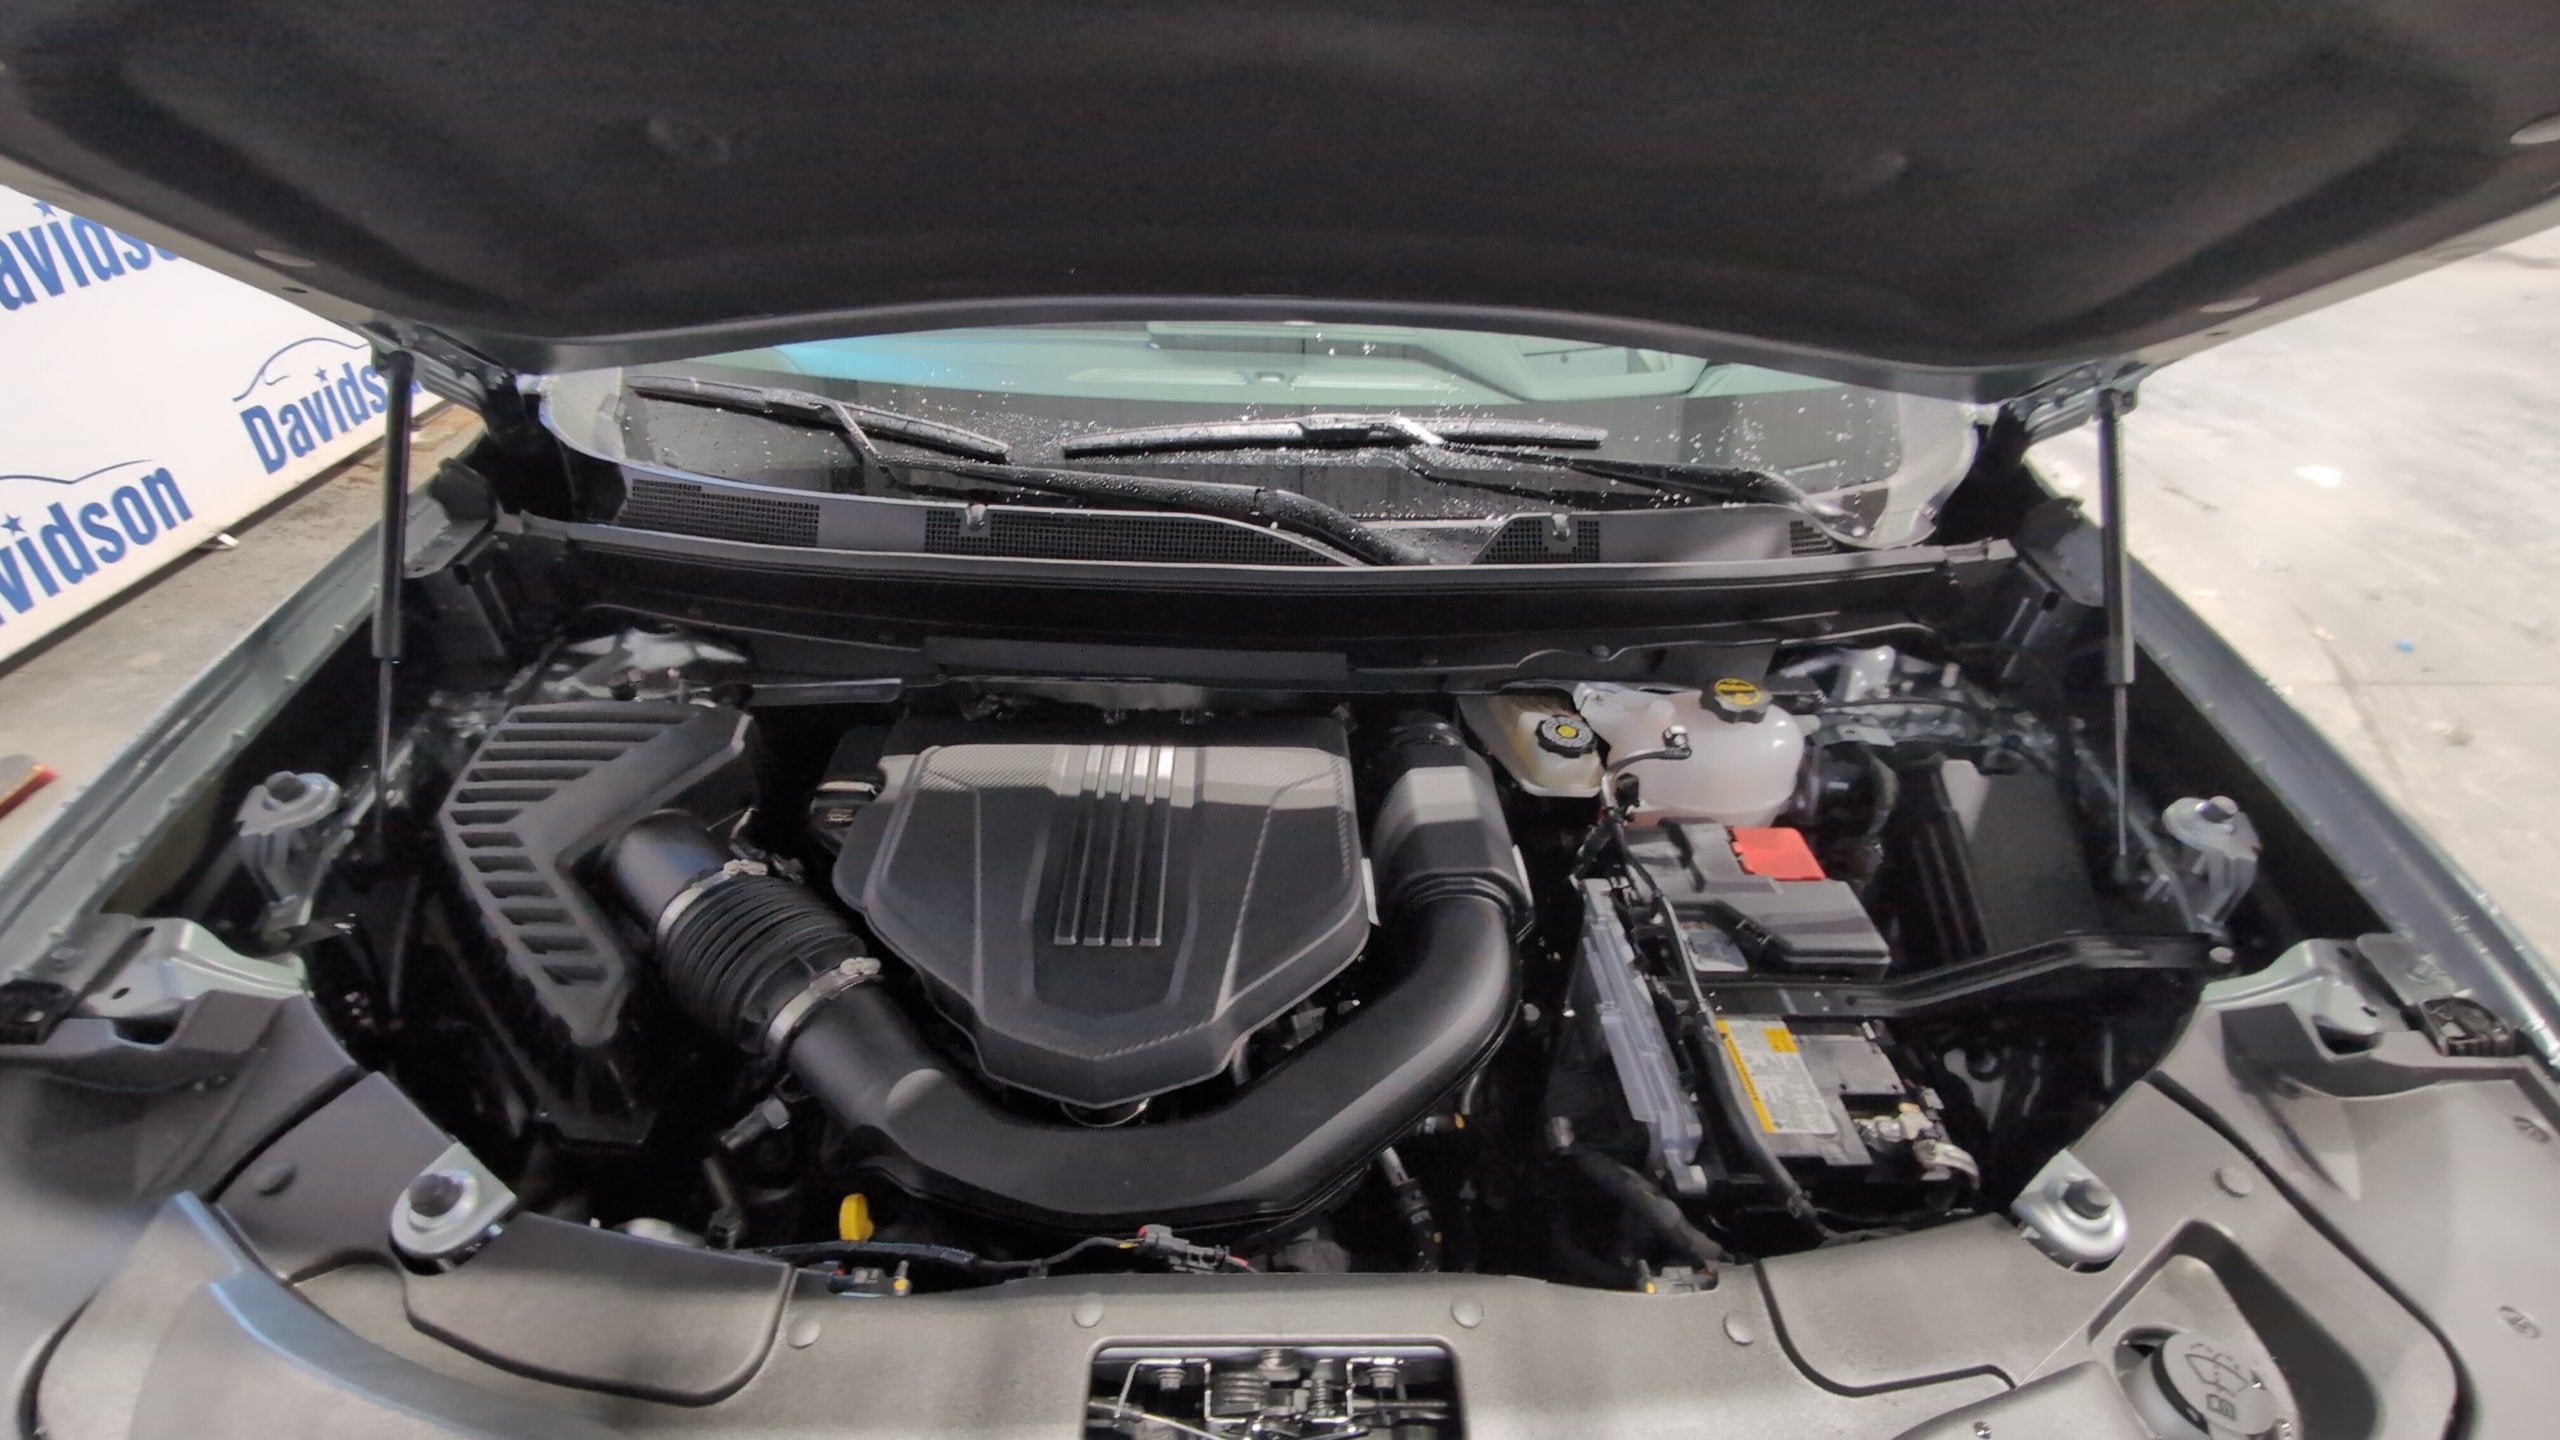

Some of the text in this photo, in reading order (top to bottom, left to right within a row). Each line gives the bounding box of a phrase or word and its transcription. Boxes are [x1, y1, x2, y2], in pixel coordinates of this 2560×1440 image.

[0, 202, 178, 310] avids
[240, 362, 420, 474] Davids
[0, 467, 193, 626] vidson
